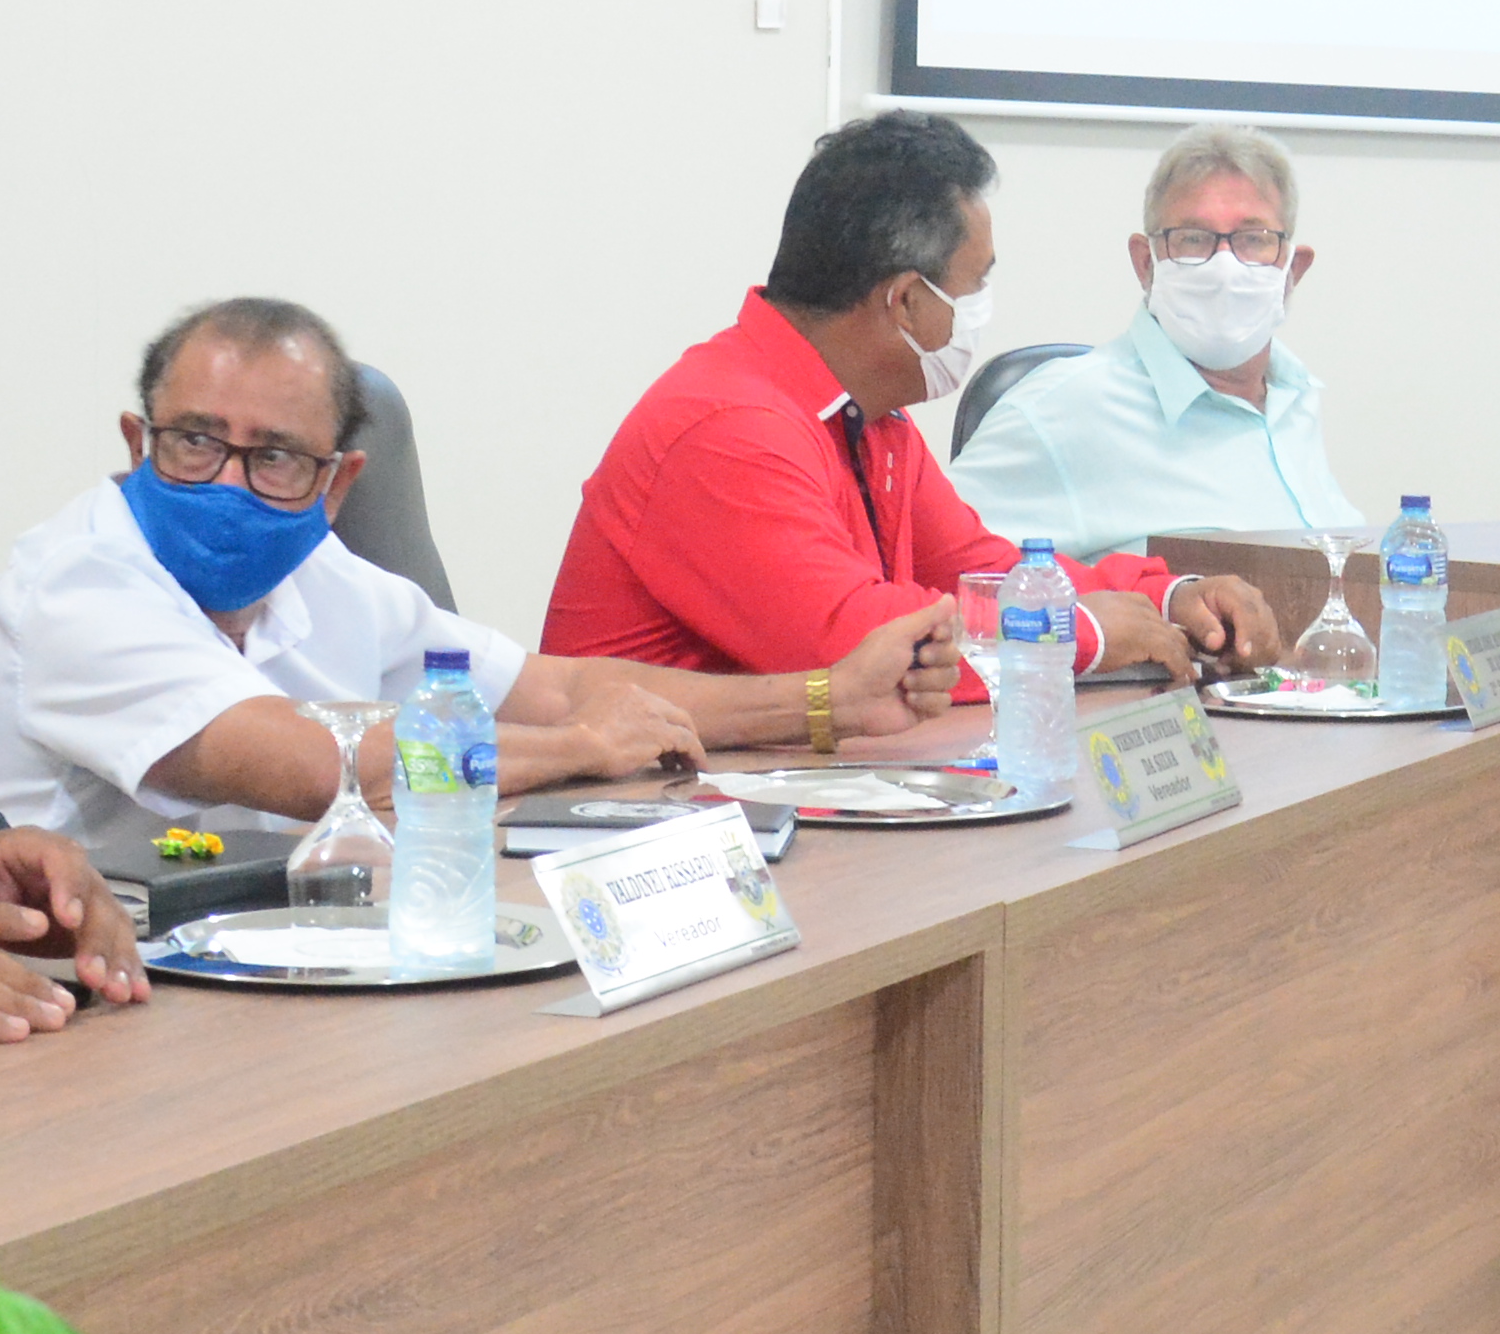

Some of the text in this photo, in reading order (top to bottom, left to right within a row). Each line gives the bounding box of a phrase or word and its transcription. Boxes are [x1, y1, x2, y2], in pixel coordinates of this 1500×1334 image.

[1142, 718, 1182, 744] OLIVEIRA
[1140, 750, 1179, 776] DA SILVA
[1148, 776, 1192, 802] Vereador
[606, 854, 718, 906] VALDINEI RISSARDI
[654, 916, 722, 948] Vereador
